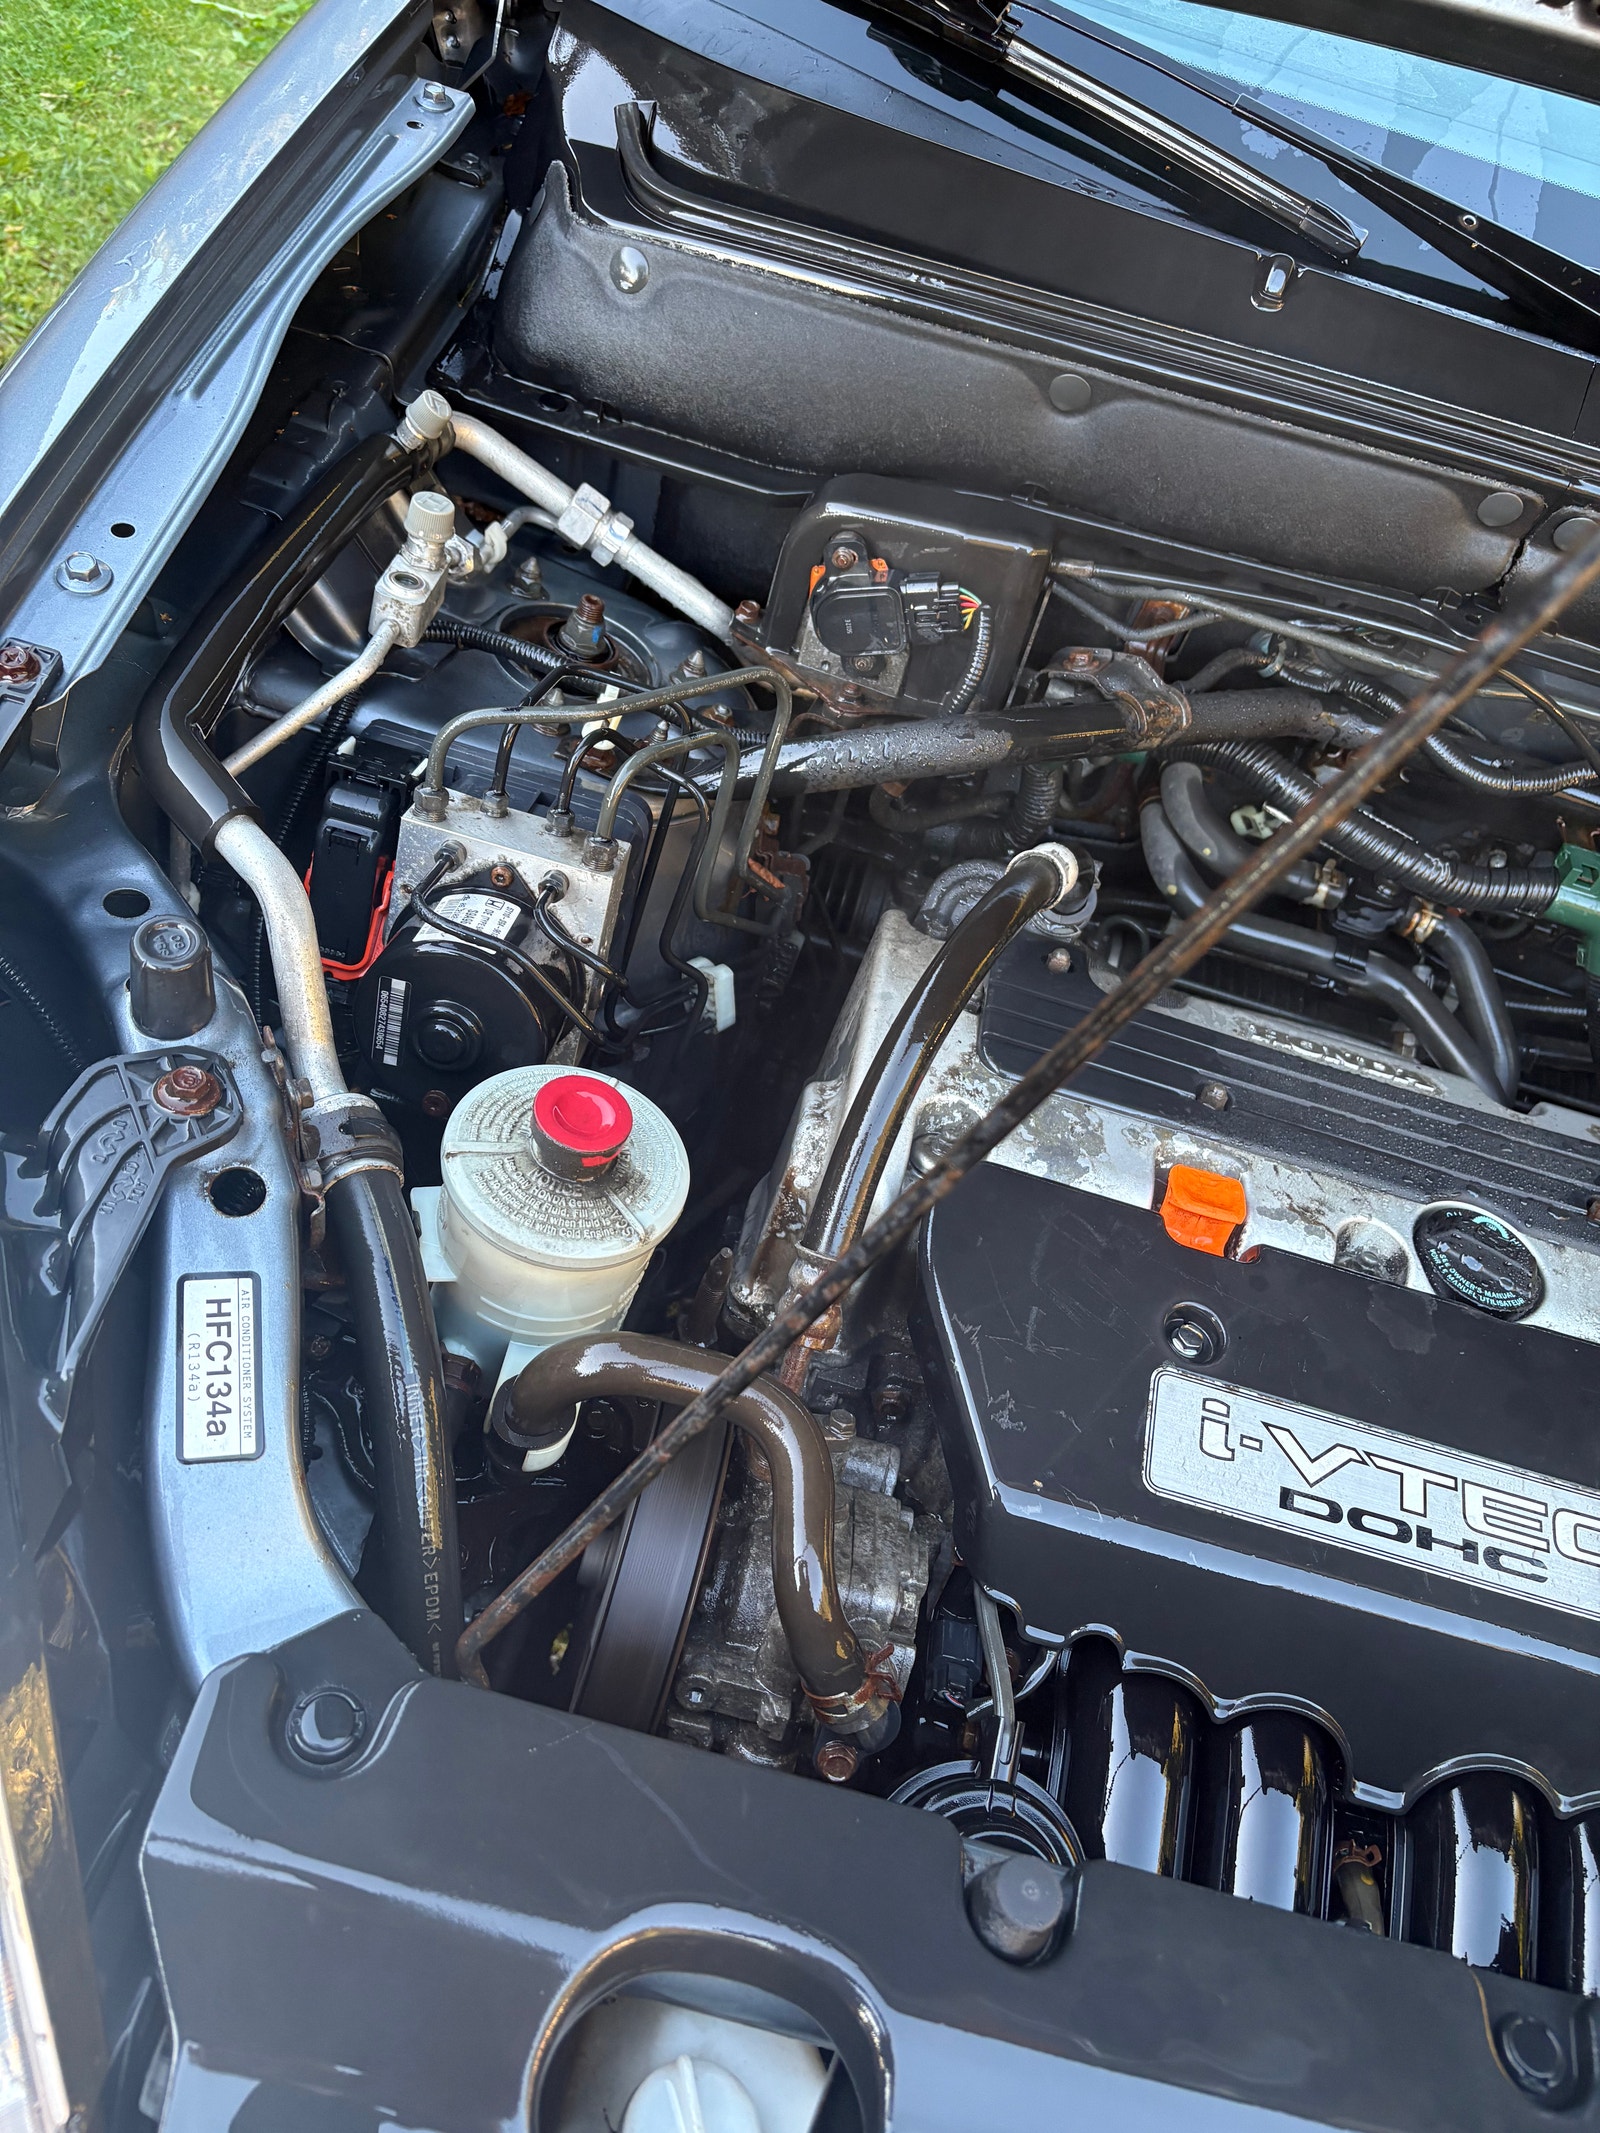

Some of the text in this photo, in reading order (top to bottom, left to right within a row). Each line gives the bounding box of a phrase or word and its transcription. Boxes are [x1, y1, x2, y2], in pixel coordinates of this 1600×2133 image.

[527, 1167, 582, 1197] NOTICE
[531, 1186, 566, 1207] HONDA
[499, 1187, 525, 1210] Upper
[523, 1206, 549, 1222] Level
[549, 1215, 576, 1228] when
[536, 1221, 556, 1236] with
[560, 1227, 580, 1239] Cold
[1440, 1253, 1516, 1299] SEE OWNER'S MANUAL
[1446, 1274, 1477, 1299] MANUEL
[1480, 1297, 1525, 1308] UTILISATEUR
[187, 1333, 200, 1402] (R134a)
[205, 1298, 232, 1437] HFC134a
[241, 1289, 253, 1440] AIR CONDITIONER SYSTEM
[1279, 1486, 1548, 1584] DOHC
